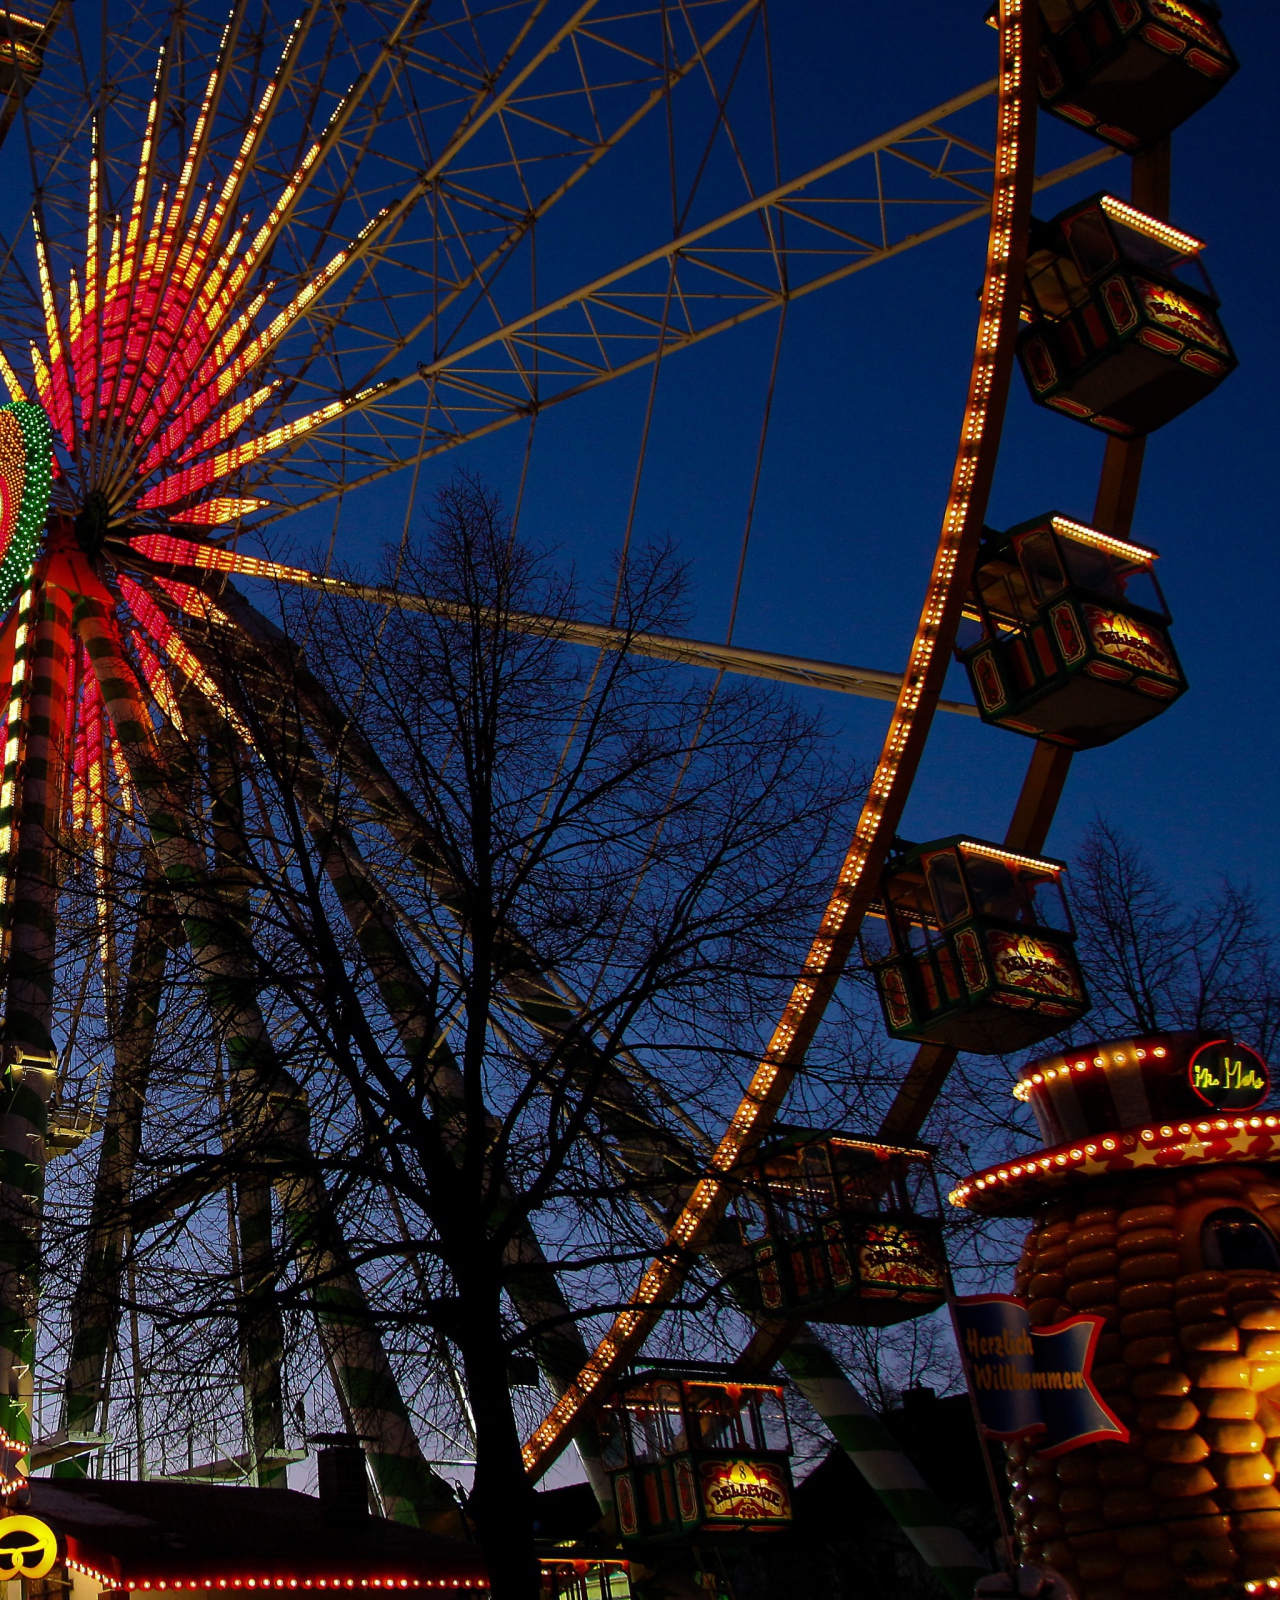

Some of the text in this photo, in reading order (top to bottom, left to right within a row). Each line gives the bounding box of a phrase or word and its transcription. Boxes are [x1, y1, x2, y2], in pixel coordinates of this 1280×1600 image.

[1118, 618, 1131, 632] 11
[1023, 940, 1036, 954] 10
[966, 1327, 1034, 1358] Herzlich
[973, 1363, 1084, 1390] Willkommen
[738, 1465, 747, 1480] 8
[711, 1483, 781, 1506] BELLEVUE
